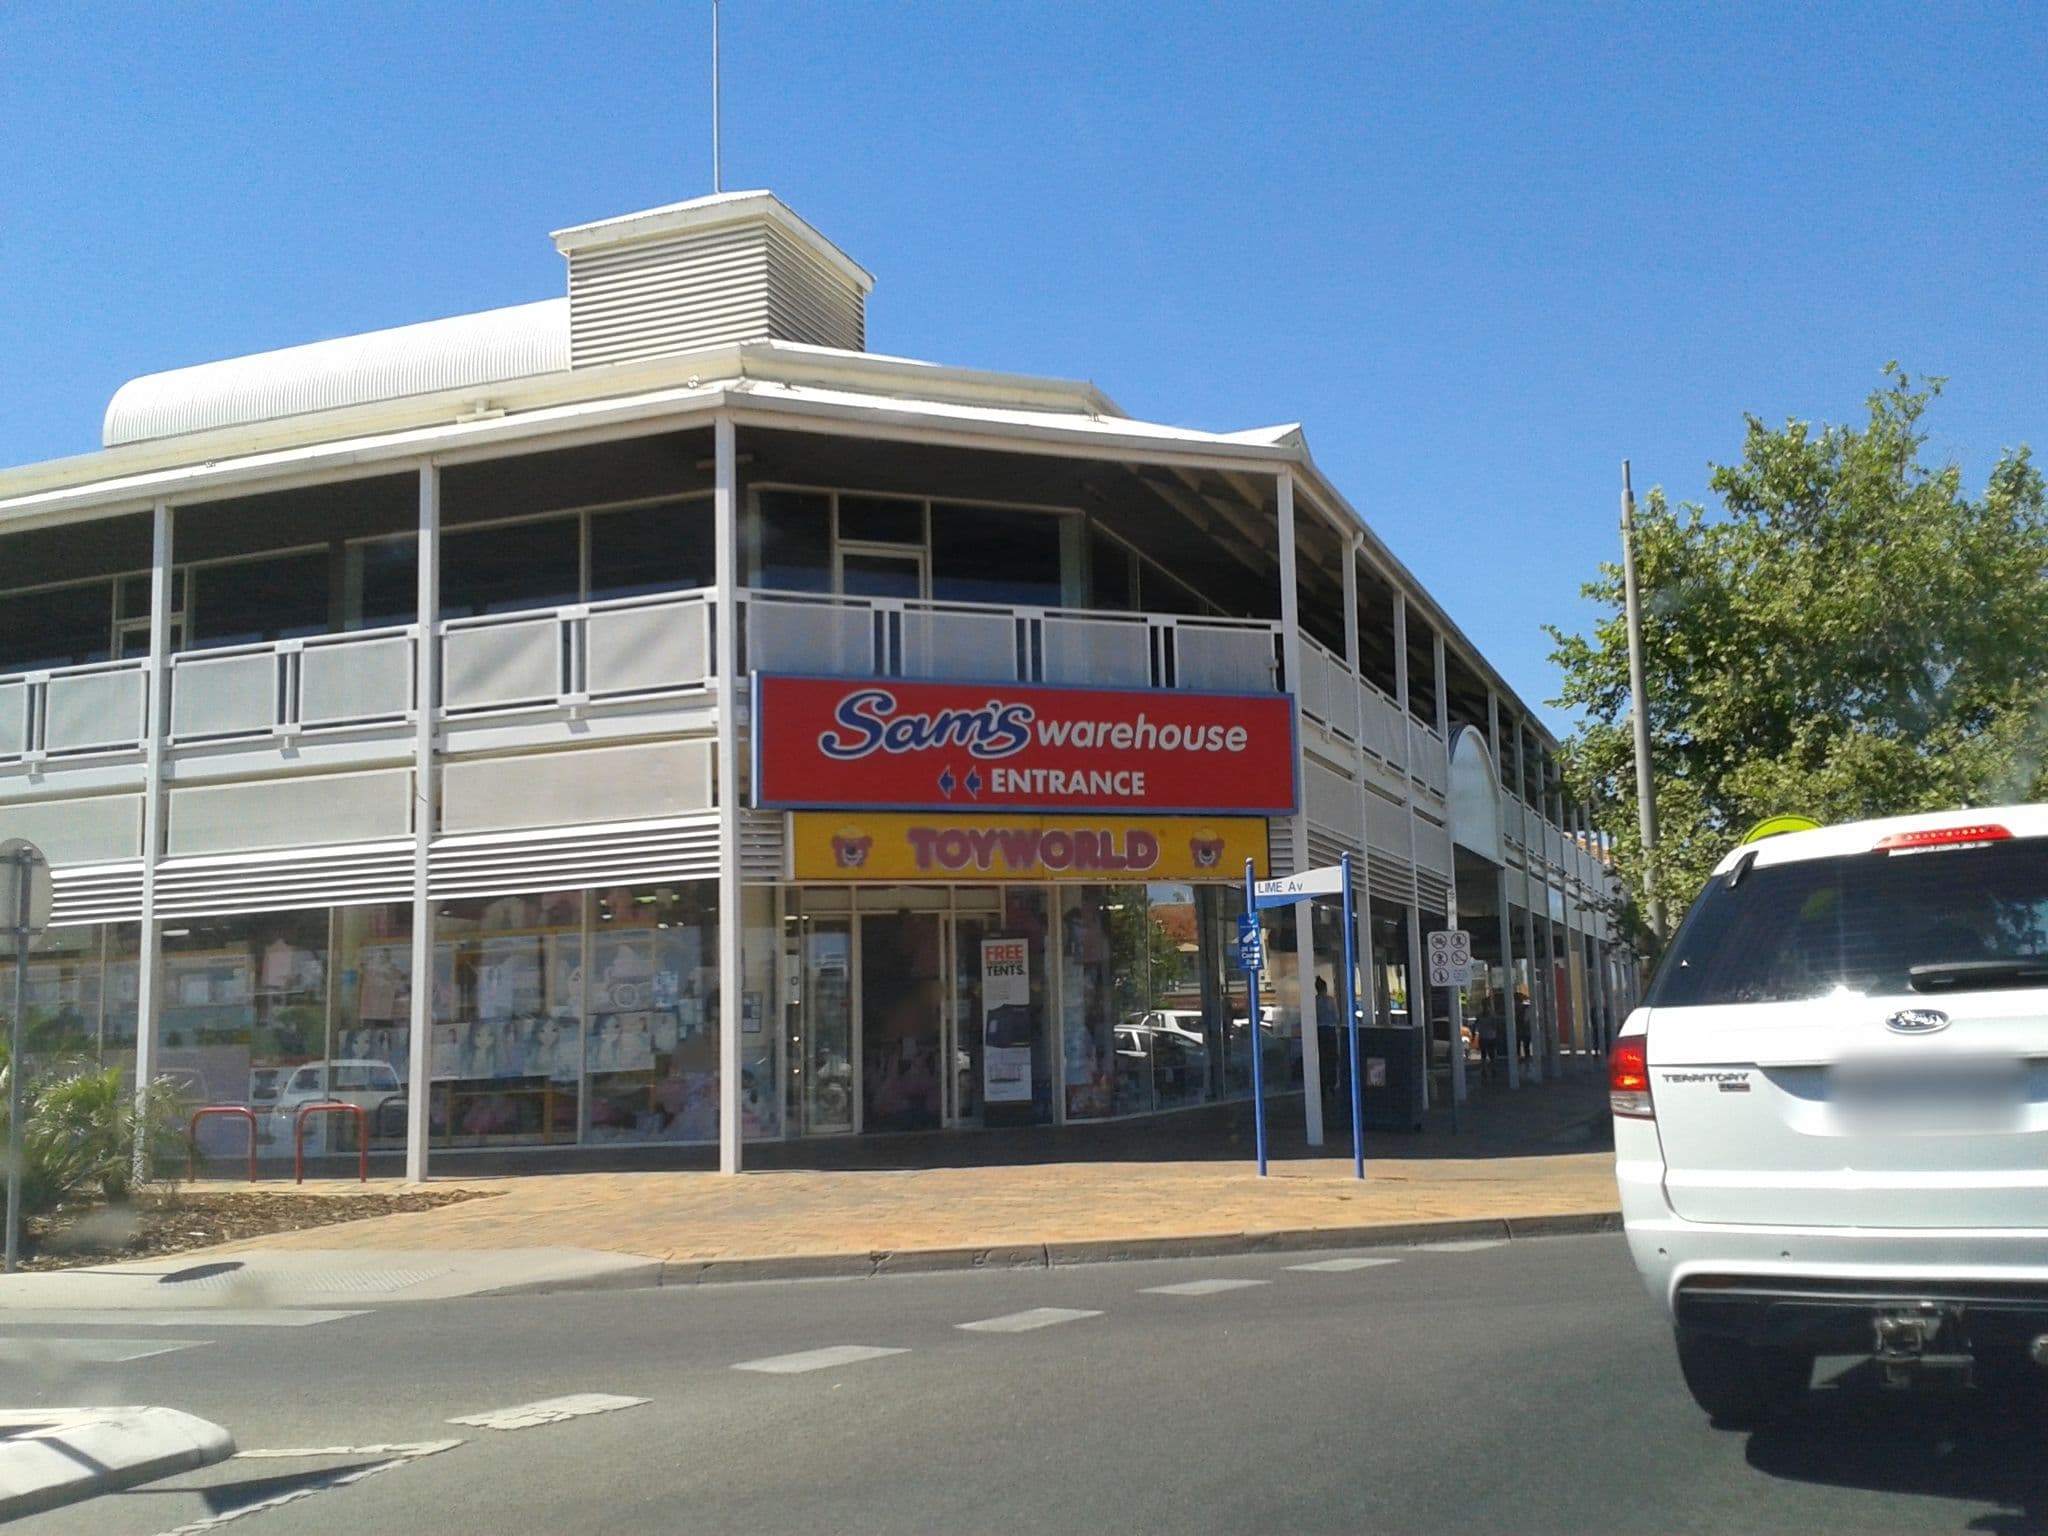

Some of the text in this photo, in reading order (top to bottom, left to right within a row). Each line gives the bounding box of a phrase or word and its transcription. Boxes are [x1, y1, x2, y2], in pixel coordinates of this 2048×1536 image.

[818, 689, 1248, 760] Sam's warehouse
[991, 768, 1145, 797] ENTRANCE
[907, 828, 1160, 872] TOYWORLD
[1258, 881, 1303, 893] LIME Av
[985, 944, 1024, 960] FREE
[1662, 1073, 1749, 1083] TERRITORY
